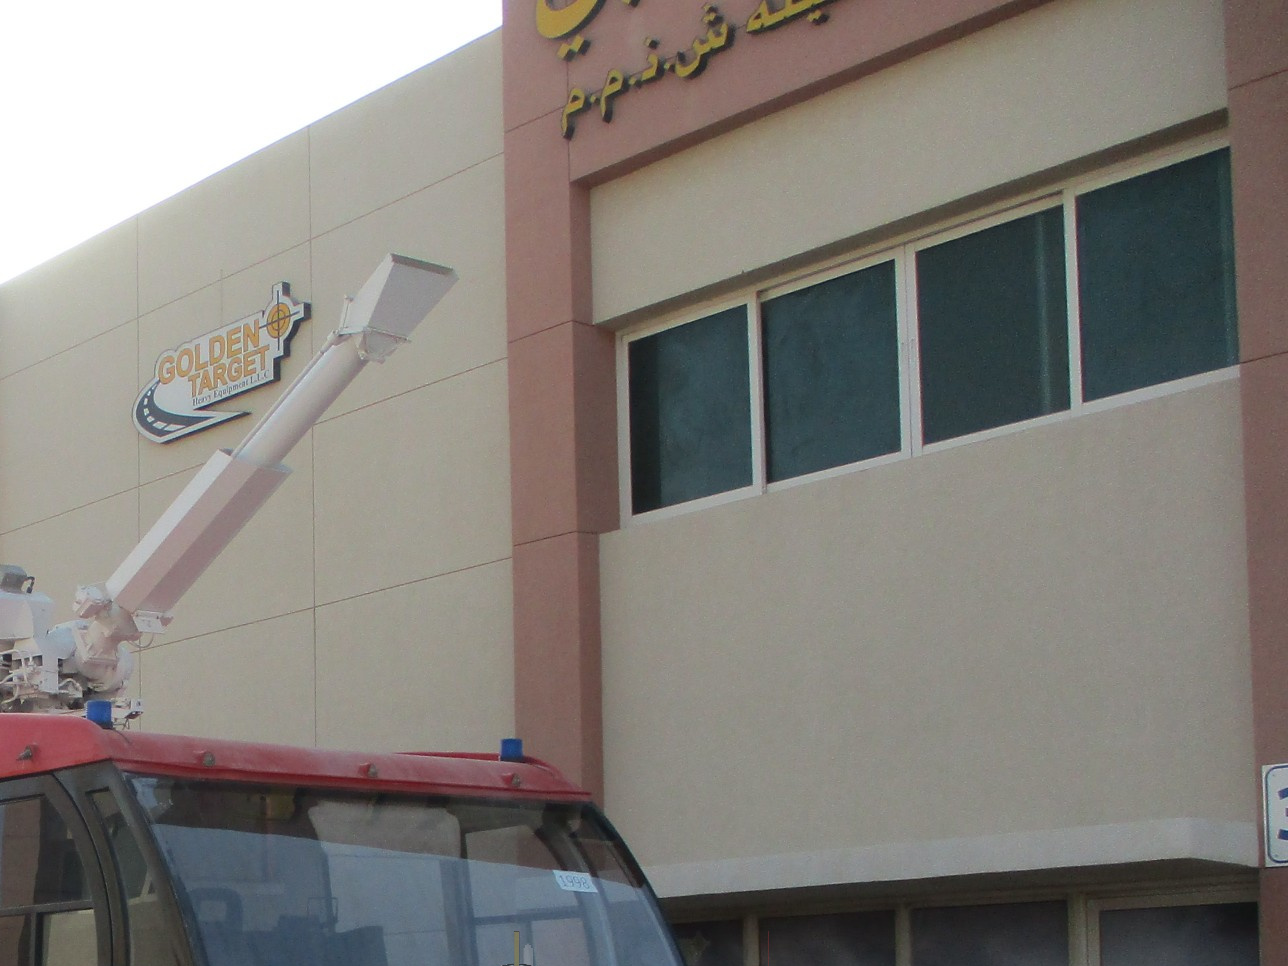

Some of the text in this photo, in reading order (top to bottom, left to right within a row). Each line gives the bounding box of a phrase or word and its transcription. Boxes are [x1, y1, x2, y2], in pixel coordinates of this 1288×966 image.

[158, 319, 261, 385] GOLDEN
[188, 344, 270, 398] TARGET
[192, 394, 212, 407] Heavy
[213, 379, 249, 398] Equipment
